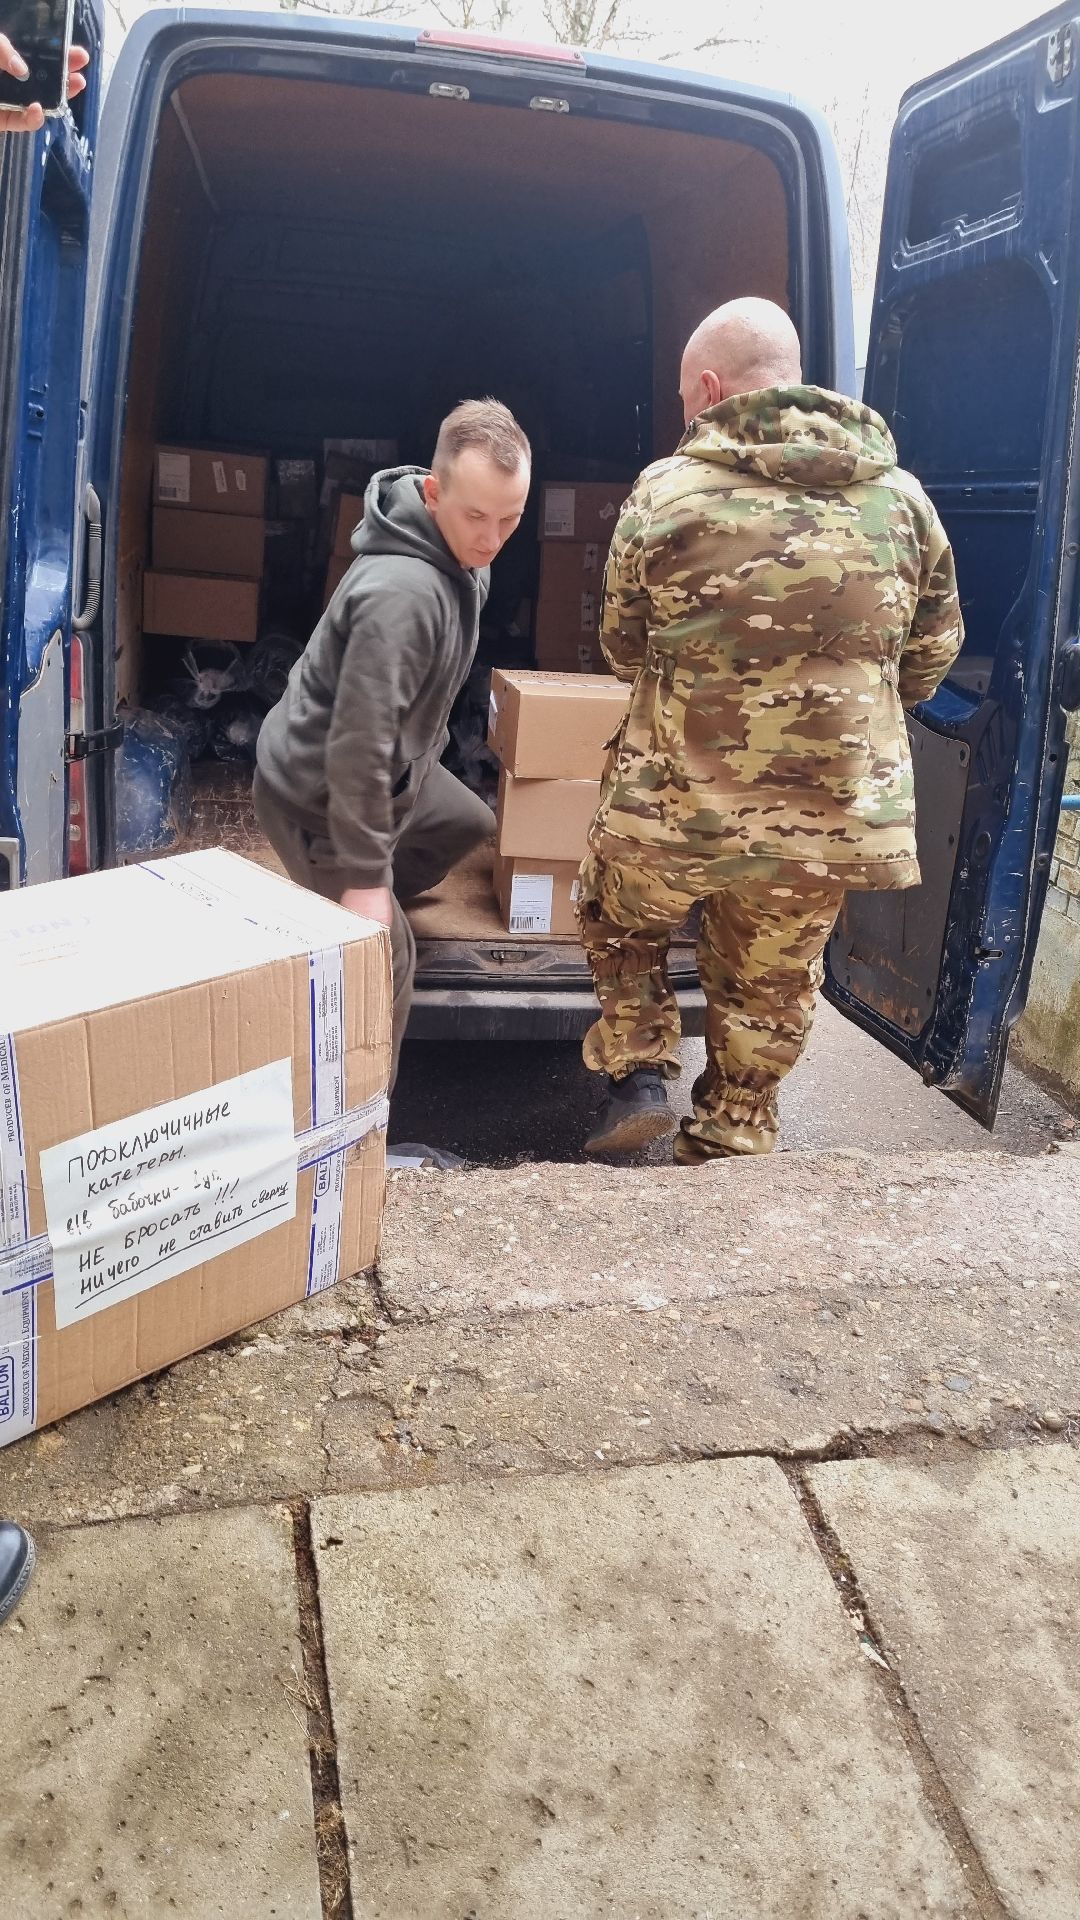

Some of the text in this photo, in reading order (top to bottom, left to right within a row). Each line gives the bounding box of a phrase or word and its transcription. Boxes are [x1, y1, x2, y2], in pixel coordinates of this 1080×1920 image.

[3, 1083, 11, 1095] OF
[5, 1098, 15, 1142] PRODUCER
[79, 1245, 105, 1273] НЕ
[22, 1291, 31, 1334] EQUIPMENT
[22, 1369, 30, 1379] OF
[22, 1380, 30, 1417] PRODUCER
